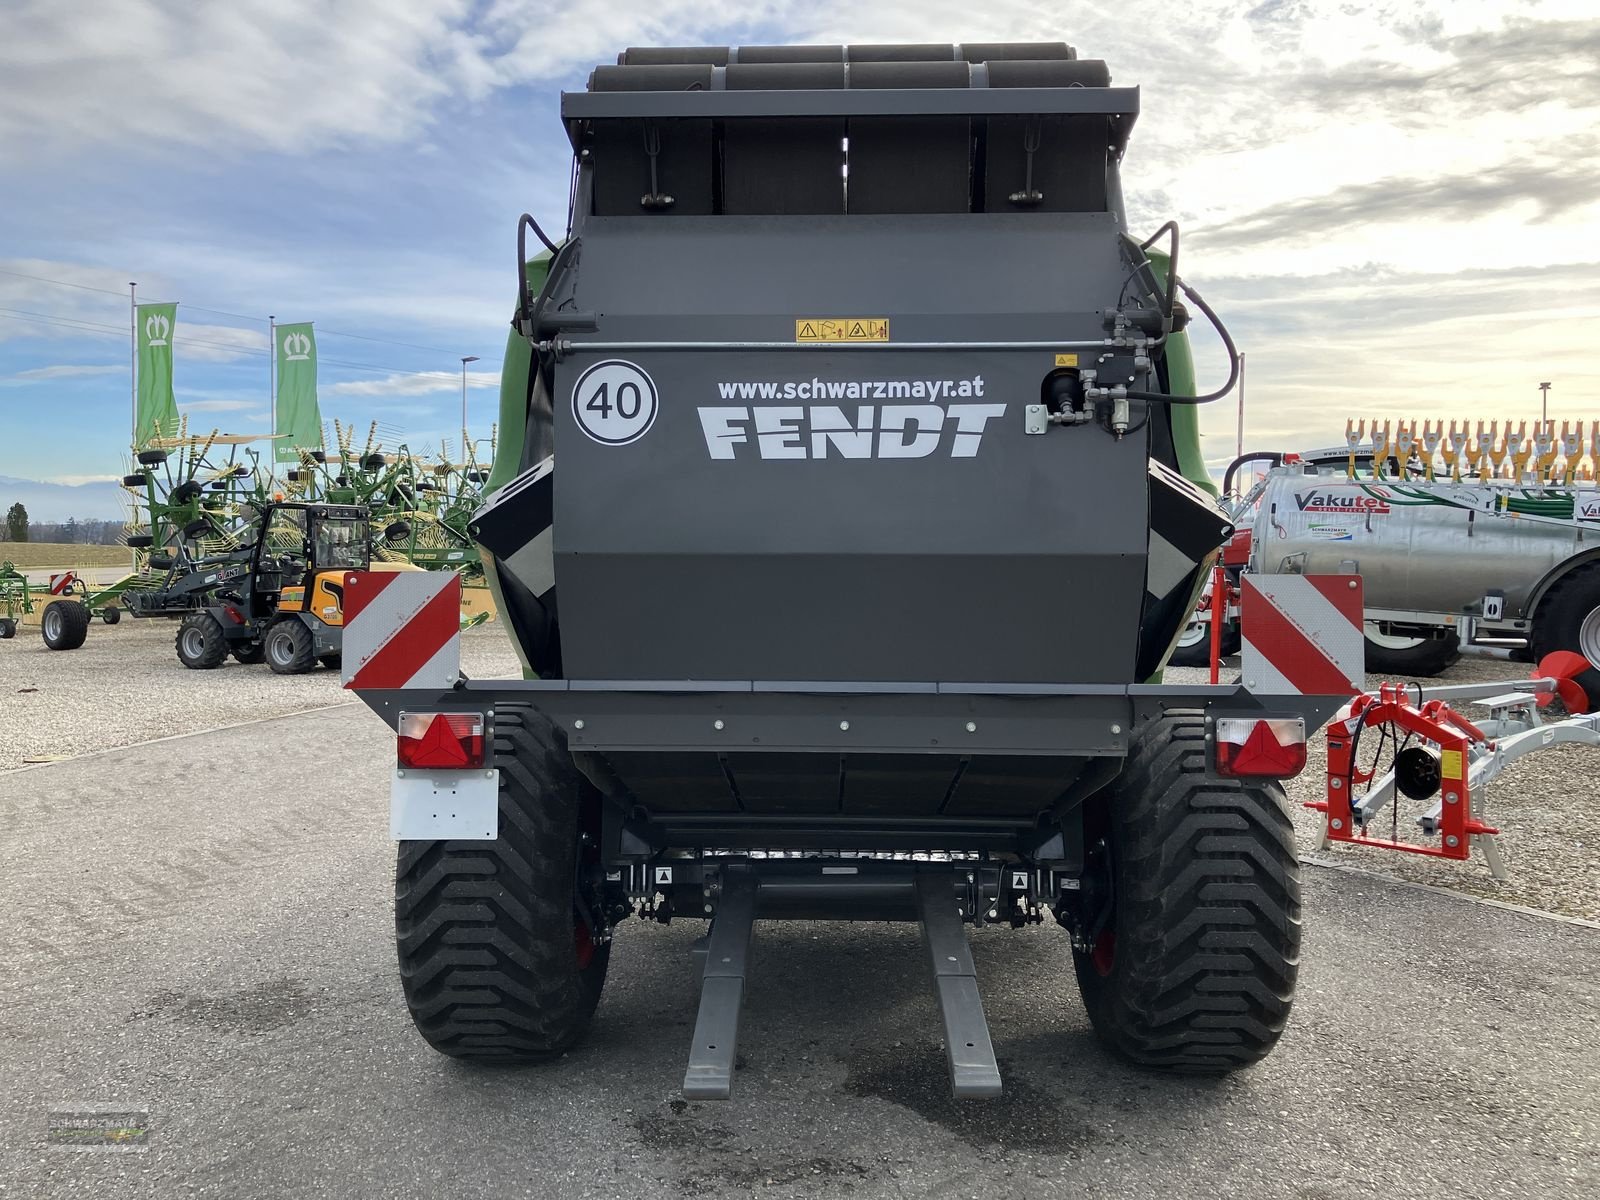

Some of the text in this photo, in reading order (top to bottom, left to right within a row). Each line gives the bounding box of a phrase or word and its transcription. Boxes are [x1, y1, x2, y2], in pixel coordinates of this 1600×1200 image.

[586, 381, 642, 420] 40
[717, 375, 985, 402] www.schwarzmayr.at
[697, 403, 1008, 460] FENDT
[1294, 490, 1391, 512] Vakutec
[217, 567, 239, 581] GIANT
